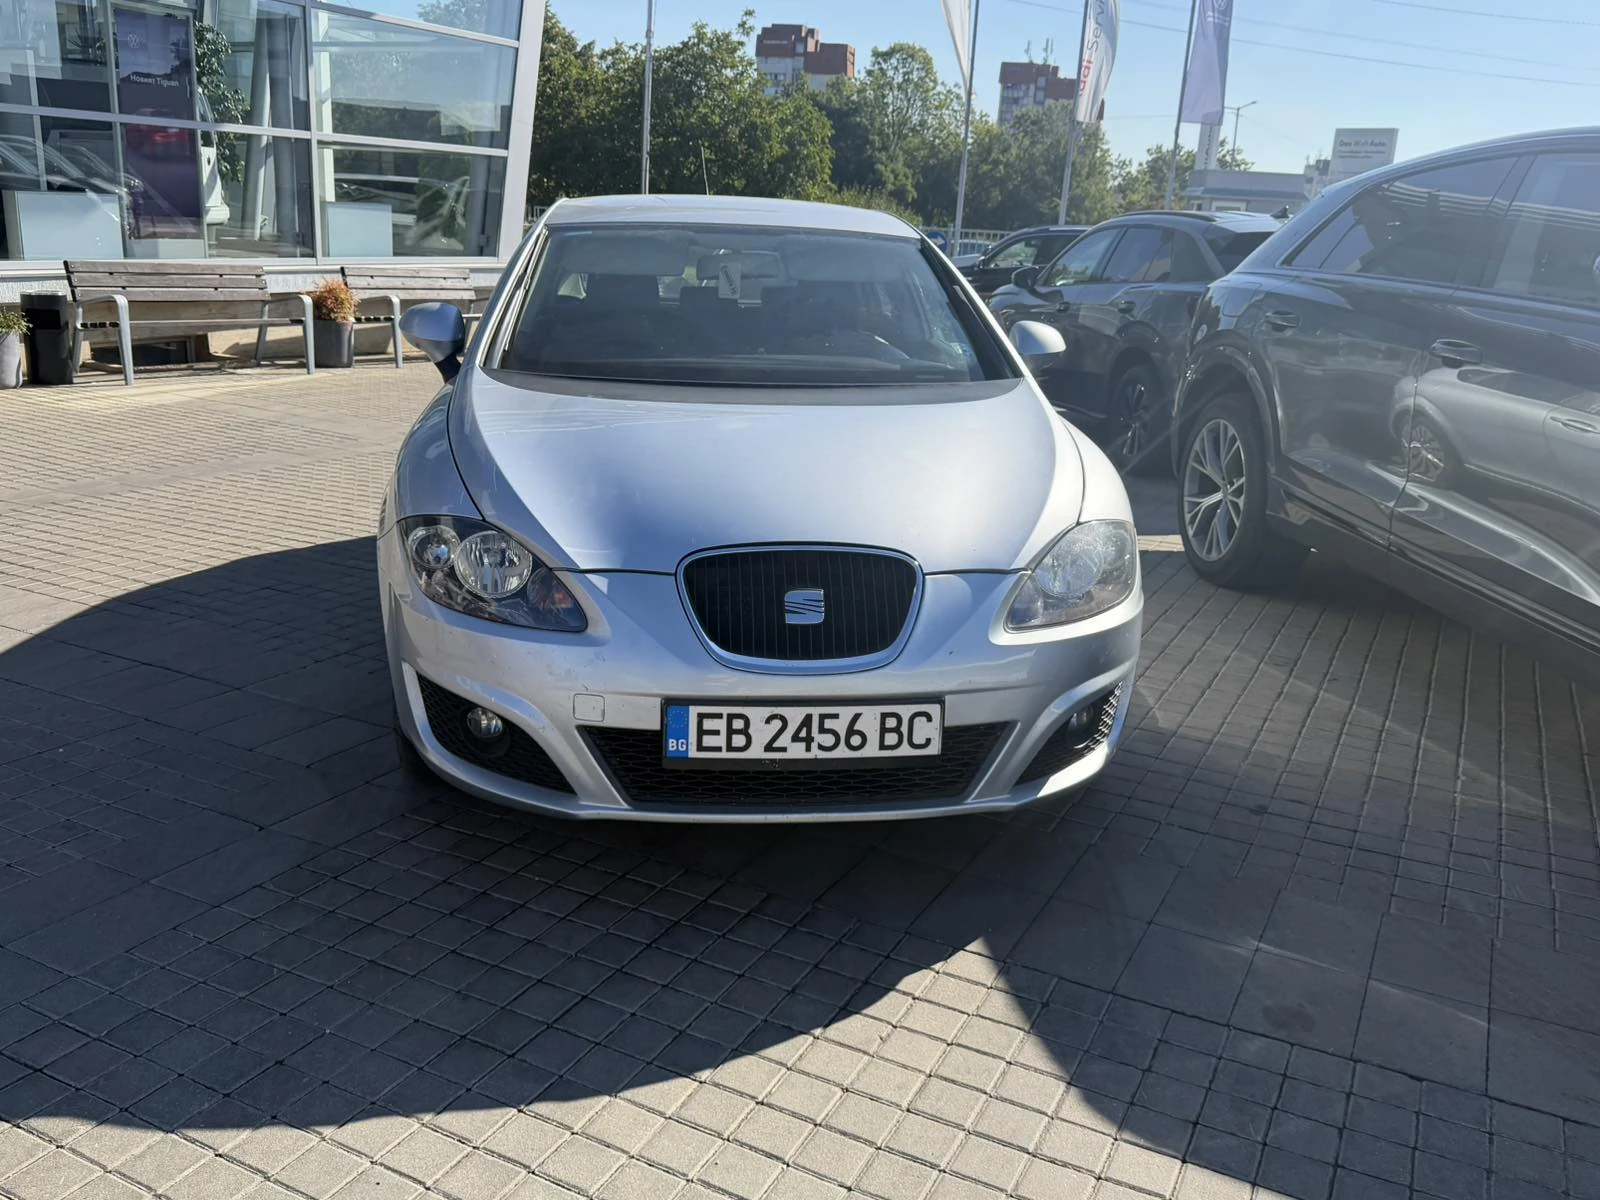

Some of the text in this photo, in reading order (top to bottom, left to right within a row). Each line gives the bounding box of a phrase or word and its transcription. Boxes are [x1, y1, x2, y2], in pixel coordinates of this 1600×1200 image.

[156, 77, 180, 88] Tiguan
[696, 710, 933, 753] EB 2456 BC
[668, 738, 687, 751] BG
